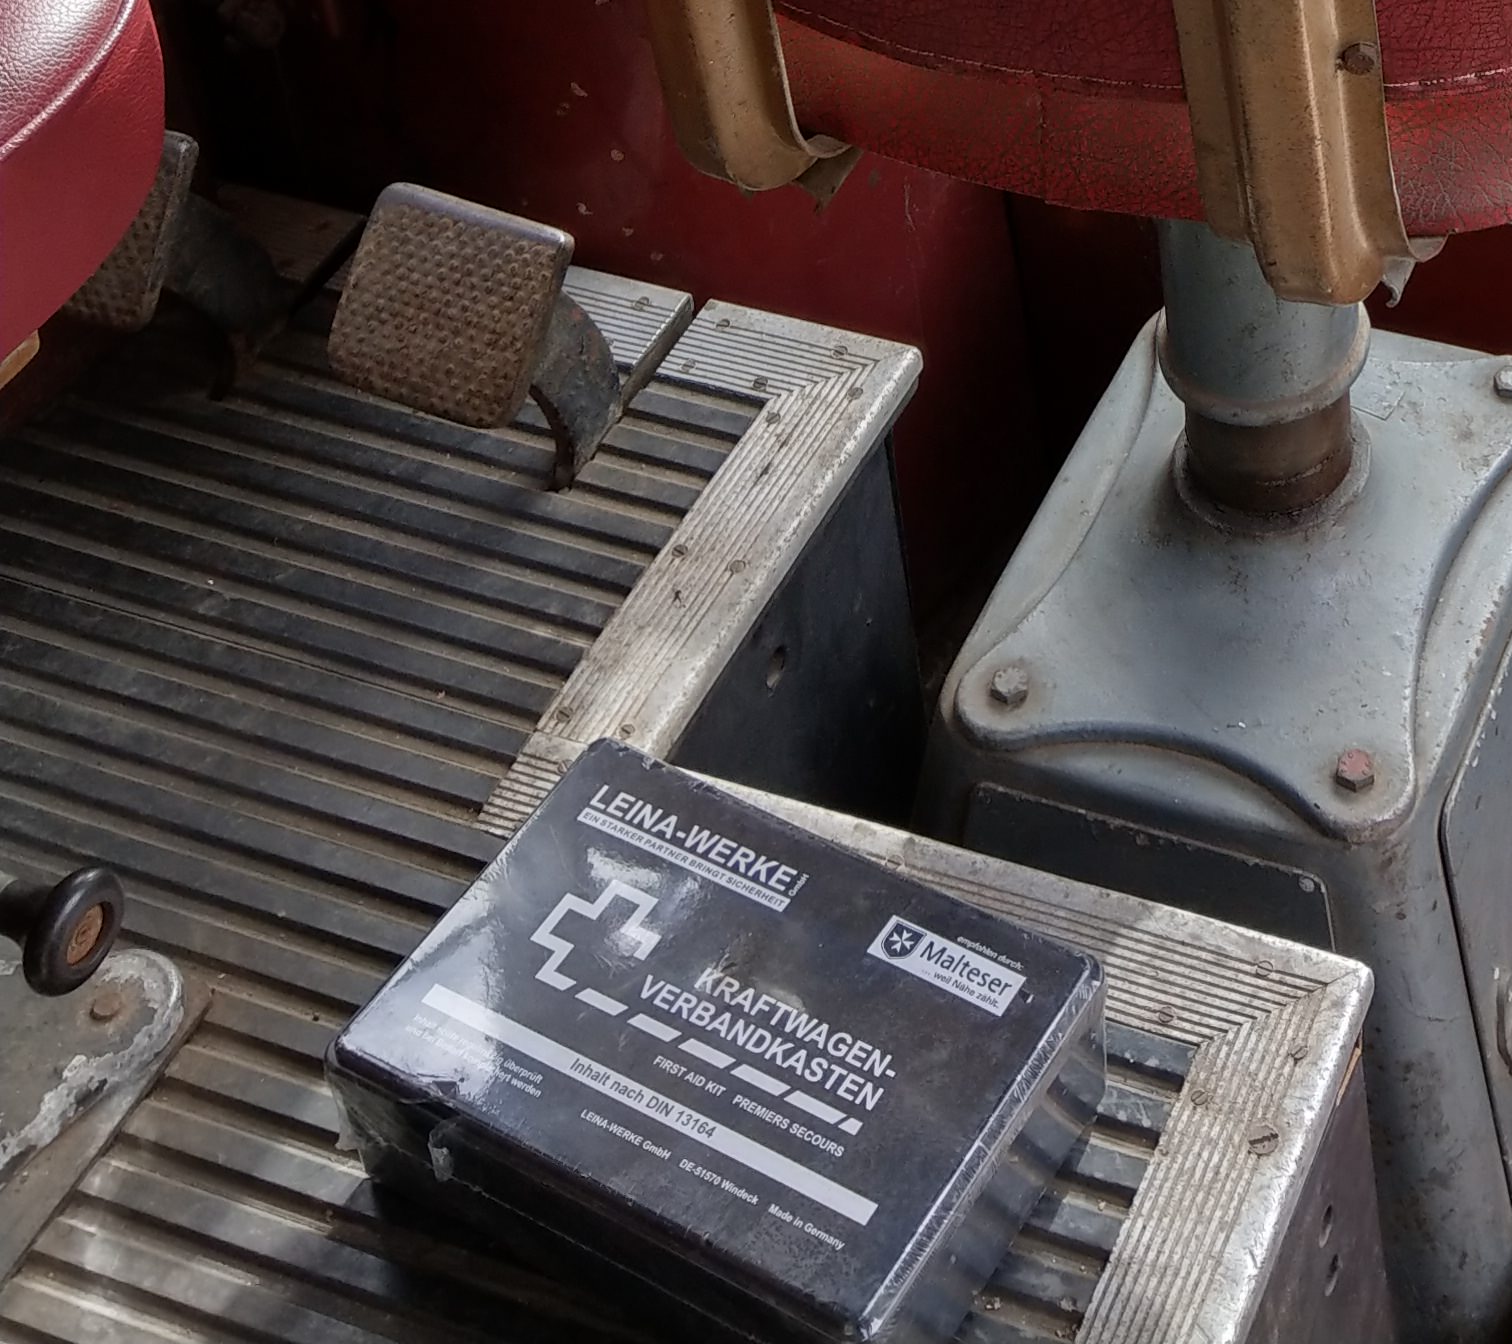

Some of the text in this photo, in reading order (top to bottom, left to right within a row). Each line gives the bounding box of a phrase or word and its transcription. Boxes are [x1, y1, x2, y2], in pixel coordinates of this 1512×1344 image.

[583, 811, 787, 909] EIN STARKER PARTNER BRINGT SICHERHEIT
[589, 784, 797, 892] LEINA-WERKE
[920, 940, 1013, 996] Malteser
[933, 972, 952, 988] weil
[951, 978, 976, 998] Nähe
[976, 991, 1000, 1010] zählt.
[956, 936, 998, 960] empfohlen
[639, 974, 884, 1112] VERBANDKASTEN
[694, 967, 897, 1081] KRAFTWAGEN-
[503, 1058, 544, 1086] überprüft
[510, 1077, 543, 1100] werden
[569, 1057, 718, 1140] Inhalt nach DIN 13164
[653, 1055, 845, 1158] FIRST AID KIT PREMIERS SECOURS
[580, 1108, 846, 1251] LEINA-WERKE GmbH DE-51570 Windeck Made in Germany
